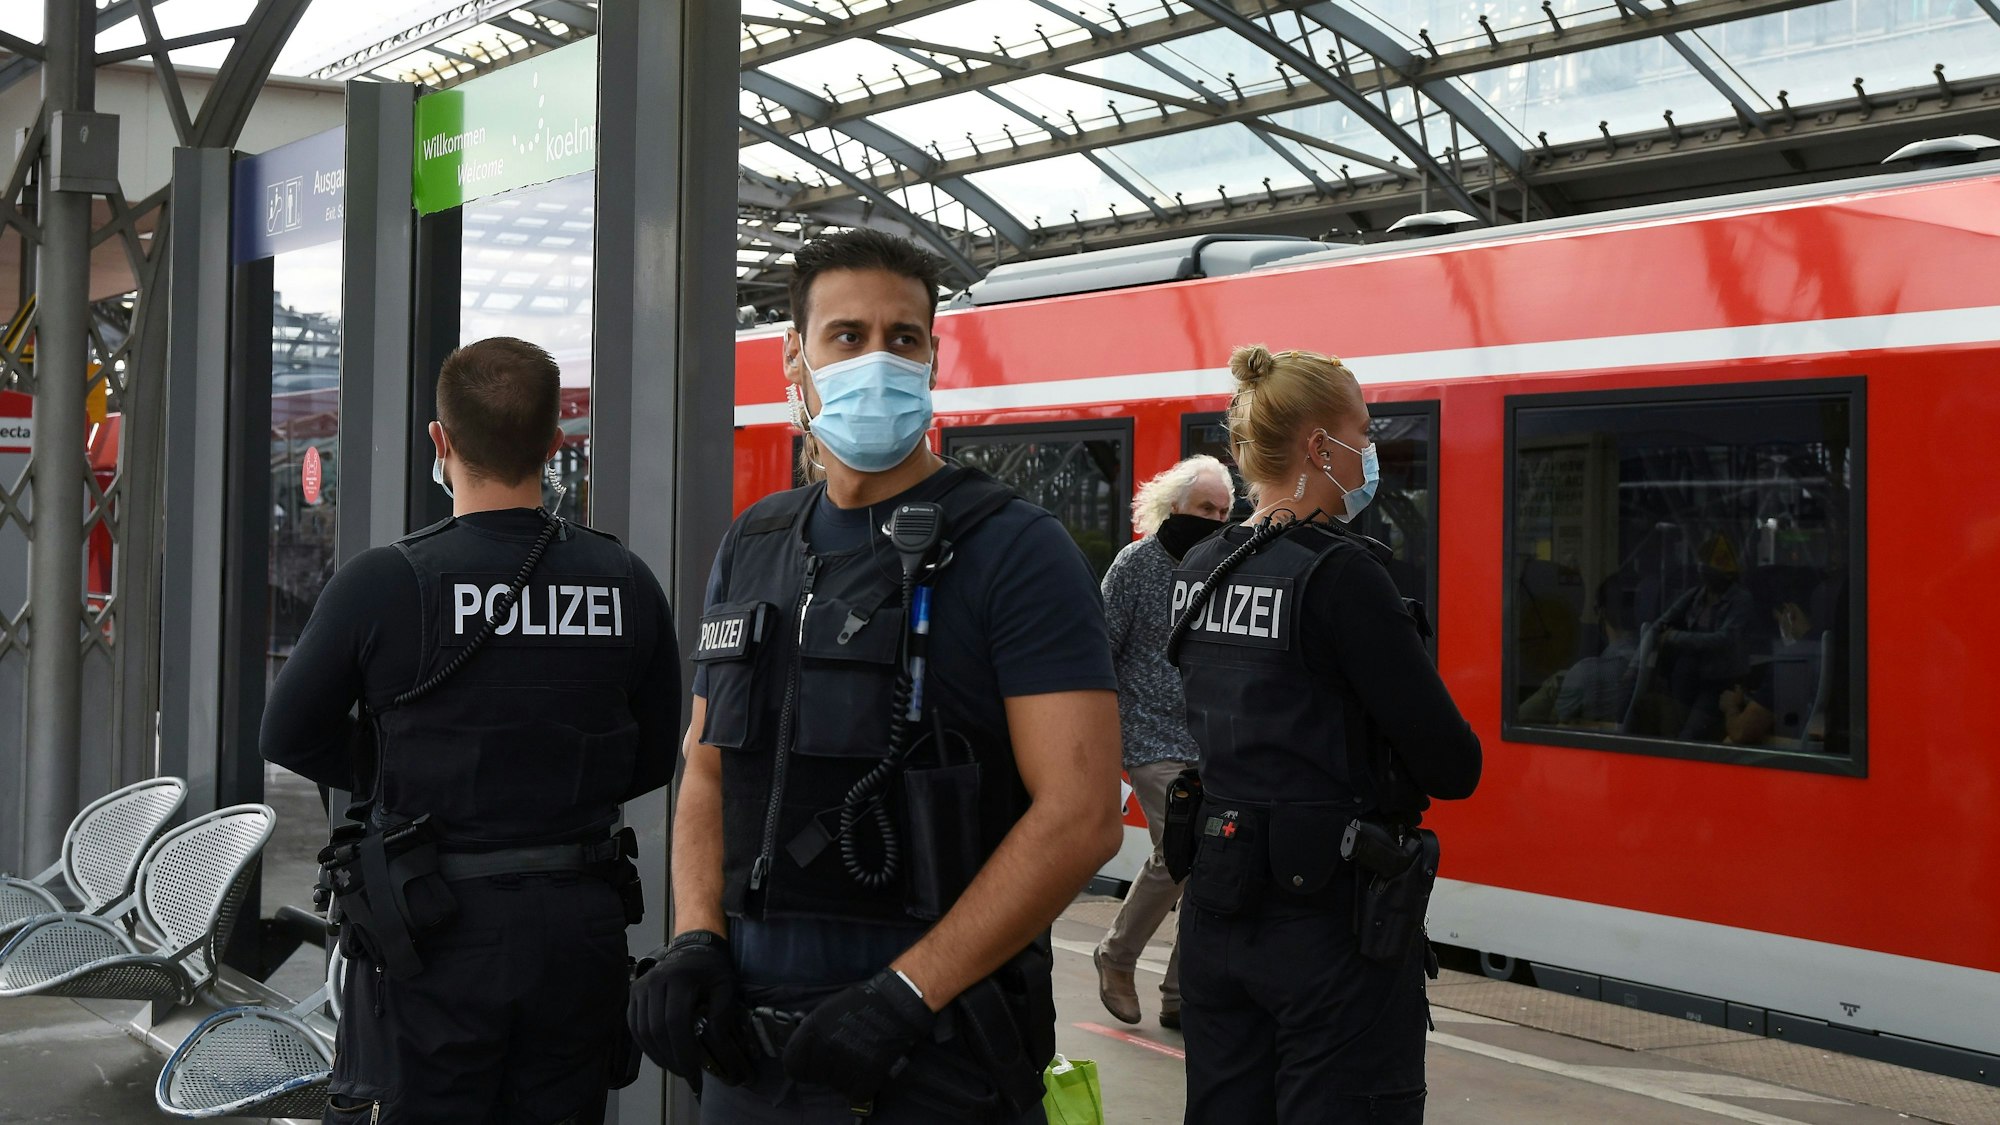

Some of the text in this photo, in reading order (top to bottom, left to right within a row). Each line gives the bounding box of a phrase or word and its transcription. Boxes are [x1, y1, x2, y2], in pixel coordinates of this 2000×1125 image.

[423, 127, 486, 161] Willkommen
[457, 158, 504, 187] Welcome
[0, 426, 31, 438] ecta
[454, 583, 622, 636] POLIZEI
[1170, 580, 1283, 639] POLIZEI
[698, 618, 744, 651] POLIZEI
